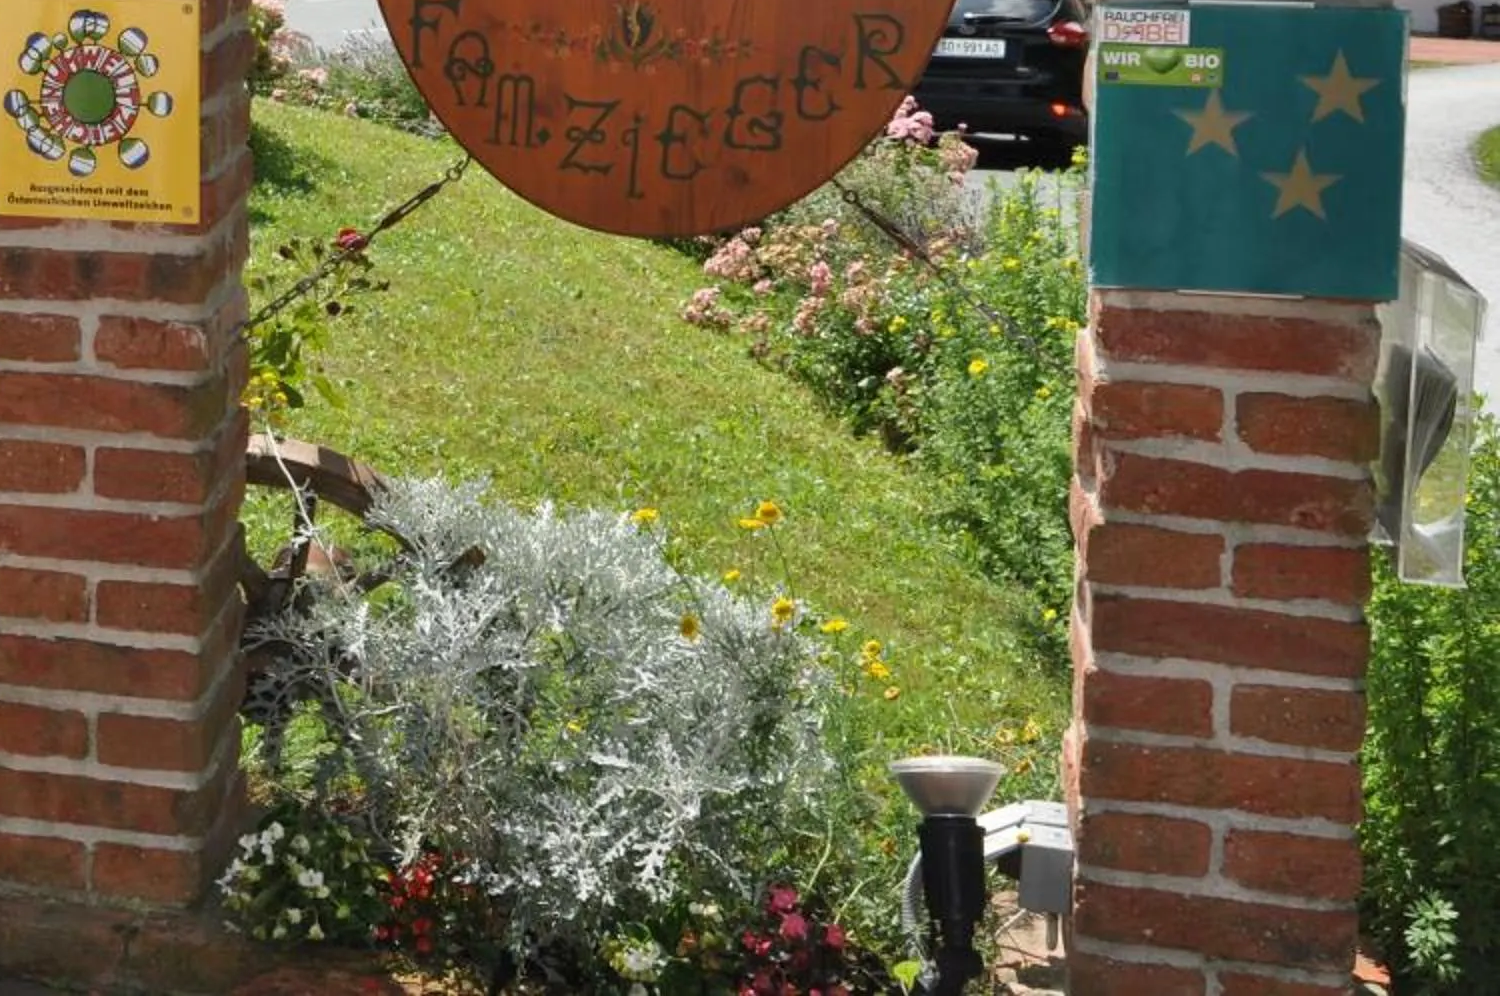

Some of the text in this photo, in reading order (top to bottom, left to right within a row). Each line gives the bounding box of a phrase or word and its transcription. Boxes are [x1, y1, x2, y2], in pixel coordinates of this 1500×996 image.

[1104, 11, 1185, 23] RAUCHFREI
[1102, 50, 1220, 69] WIR BIO
